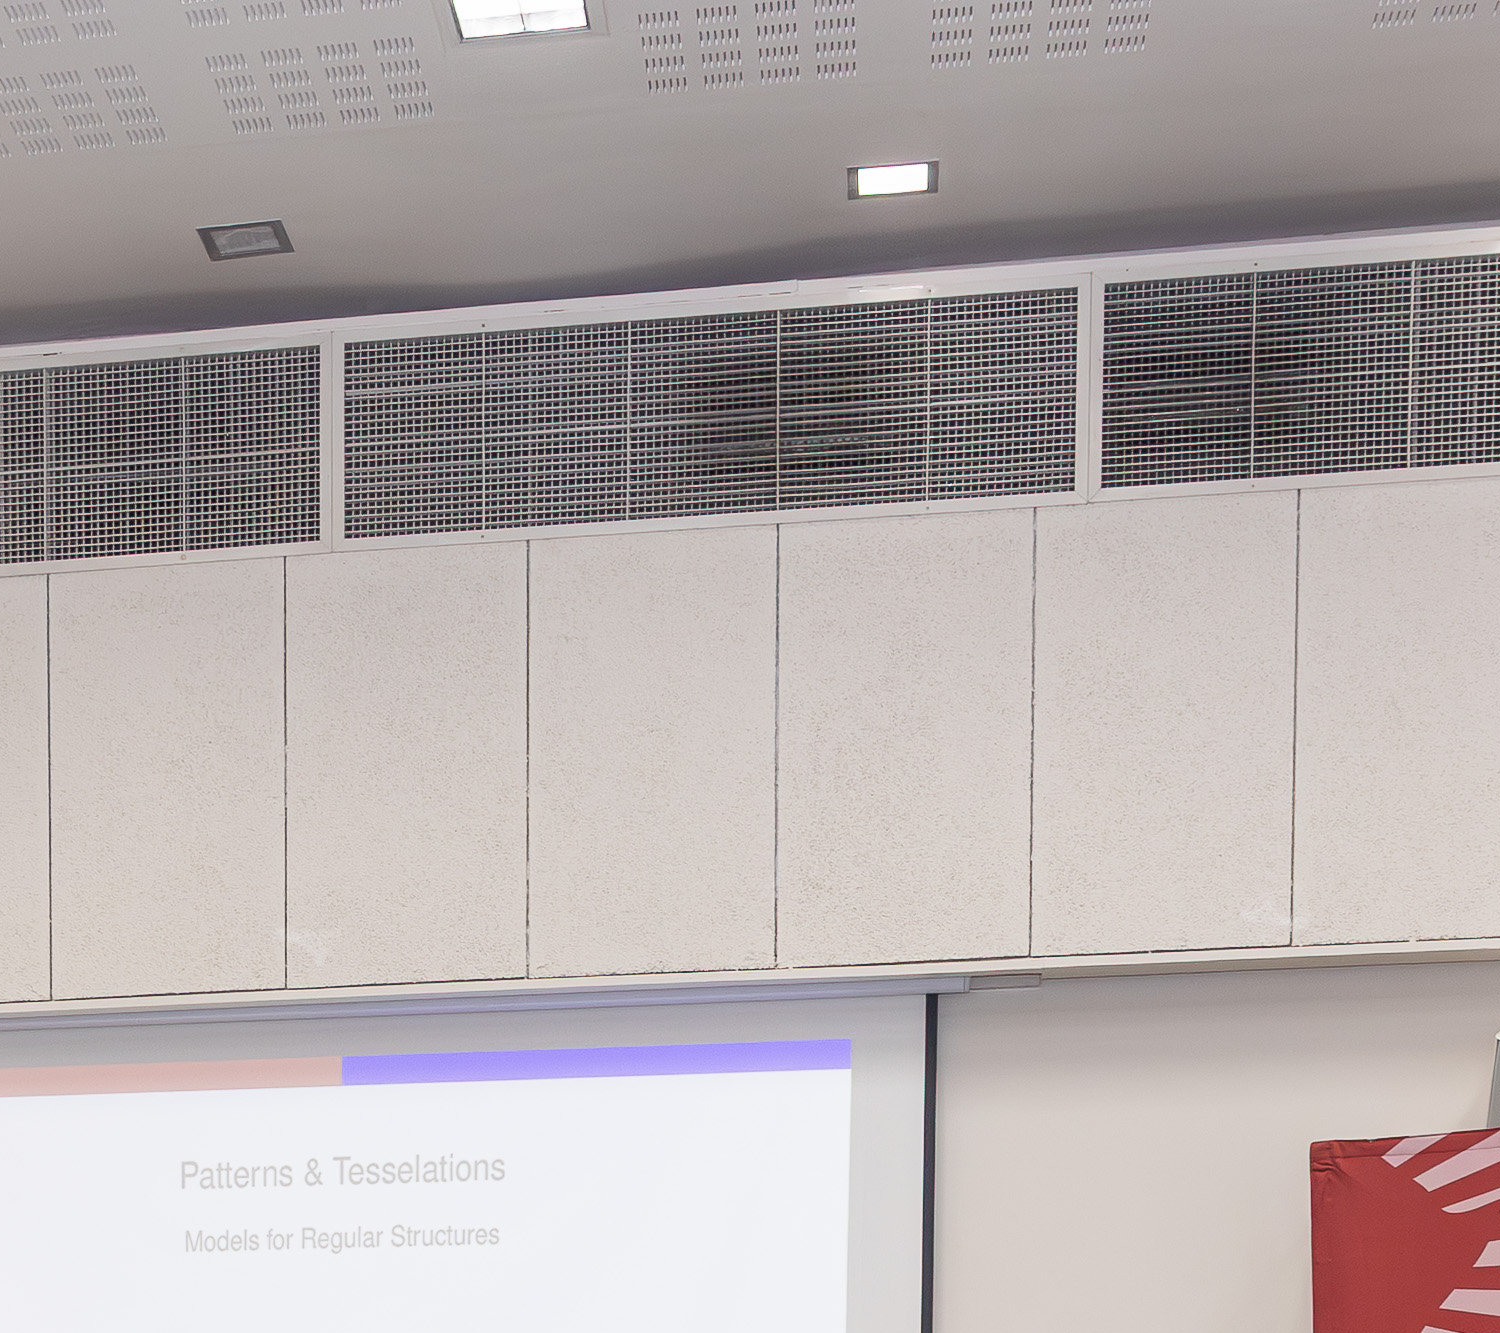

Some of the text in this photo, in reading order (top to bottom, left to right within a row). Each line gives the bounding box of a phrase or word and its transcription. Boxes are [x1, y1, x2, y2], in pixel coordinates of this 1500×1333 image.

[180, 1152, 506, 1190] Patterns & Tesselations
[184, 1224, 500, 1255] Models for Regular Structures
